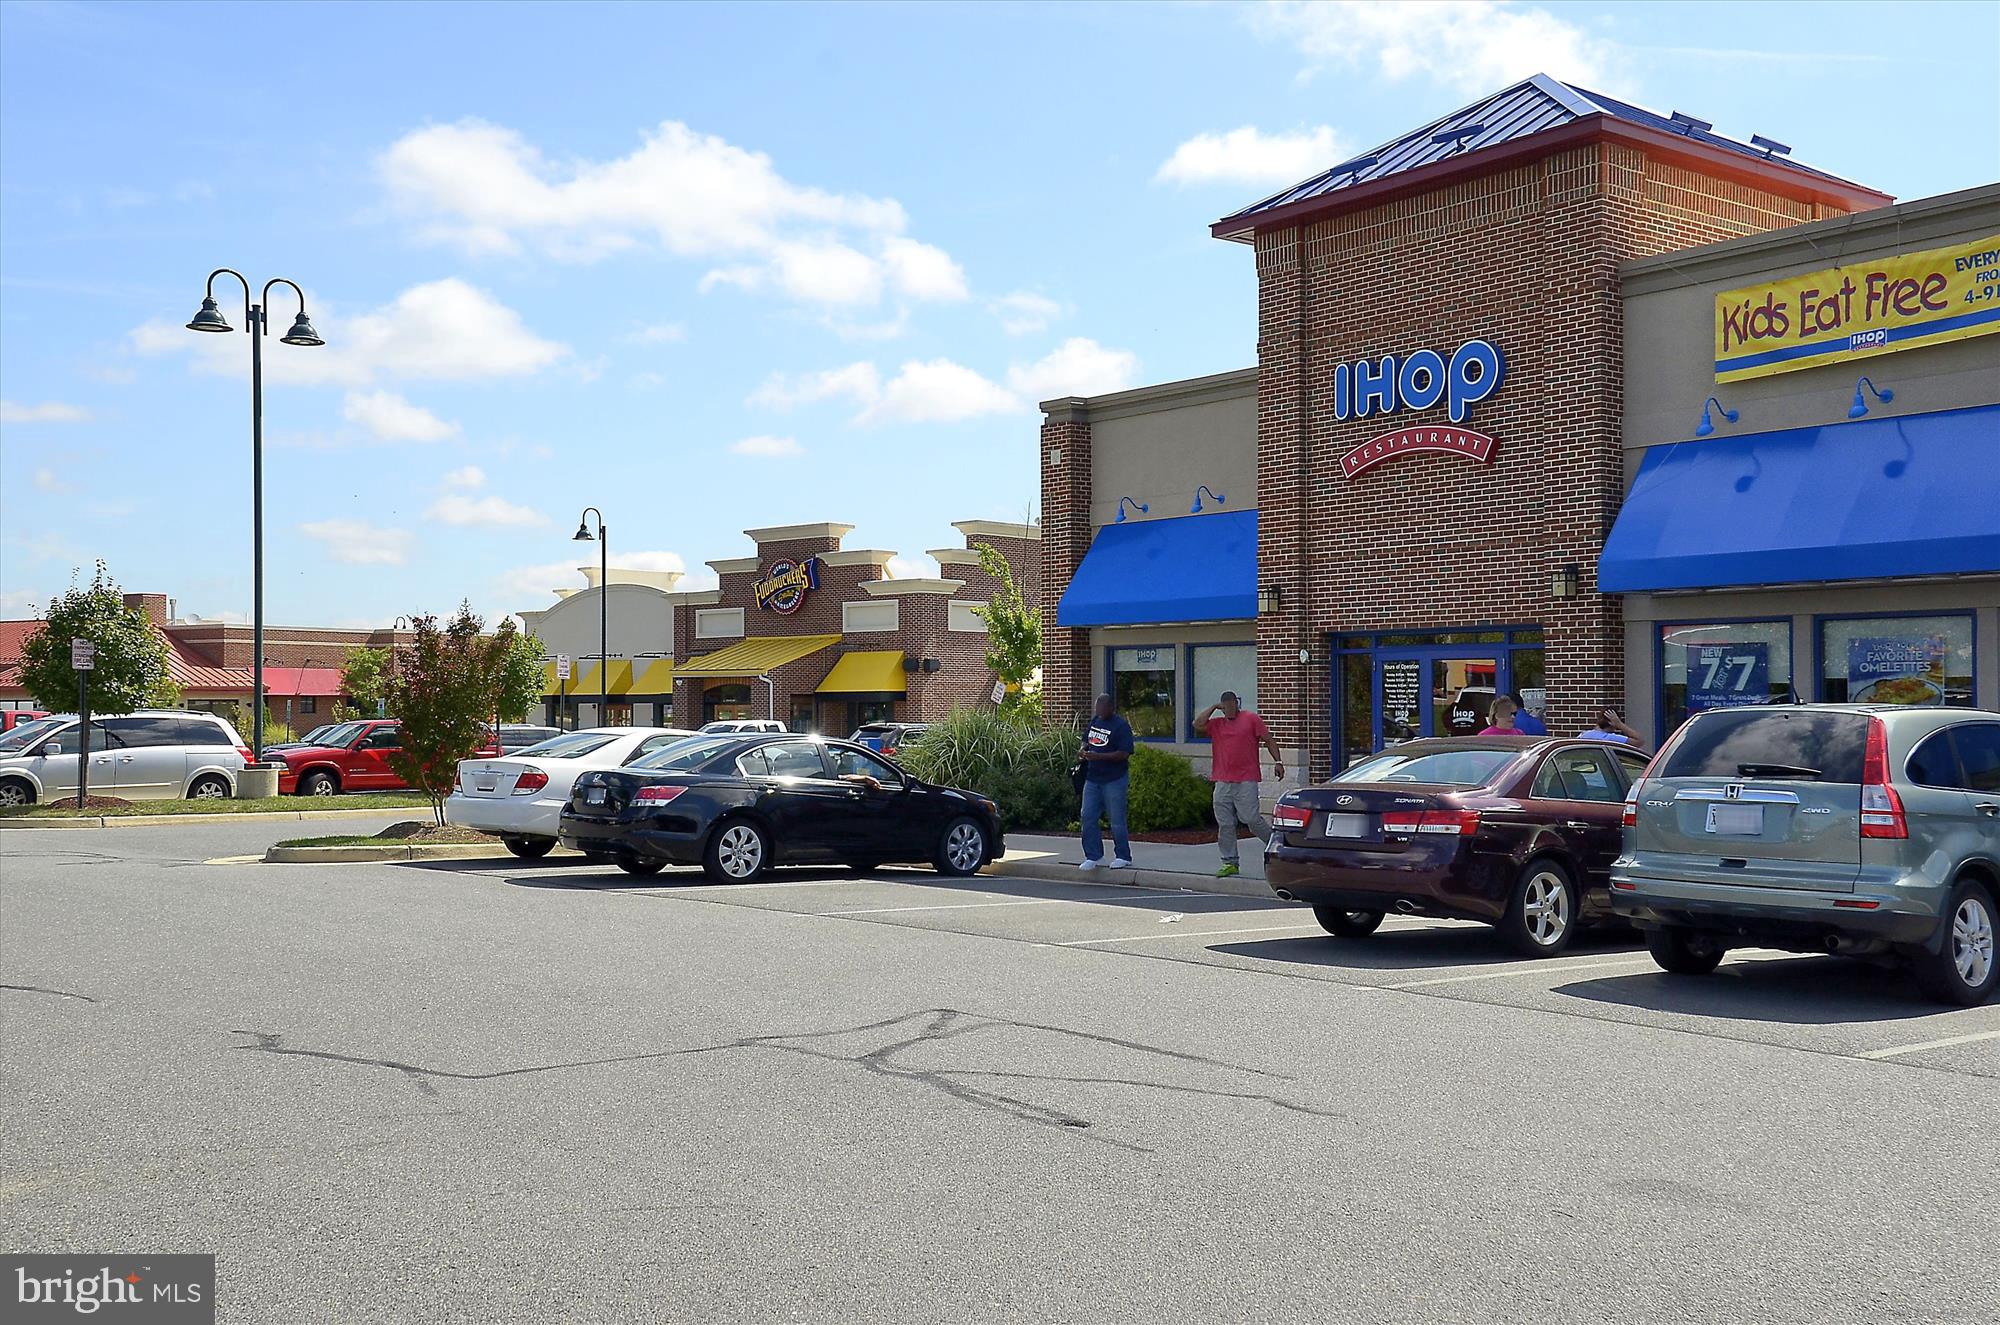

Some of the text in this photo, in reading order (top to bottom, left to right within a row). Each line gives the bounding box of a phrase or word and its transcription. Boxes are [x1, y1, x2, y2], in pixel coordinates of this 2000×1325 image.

[1955, 249, 2000, 272] EVERY
[1976, 269, 2000, 283] FRO
[1723, 272, 1948, 352] Kids Eat Free
[1852, 331, 1884, 345] IHOP
[1334, 339, 1503, 423] IHOP
[1350, 432, 1481, 467] RESTAURANT
[754, 562, 808, 608] FUDDRUCKERS
[1701, 648, 1722, 658] NEW
[1867, 651, 1923, 661] FAVORITE
[1700, 657, 1720, 690] 7
[1859, 661, 1931, 673] OMELETTES
